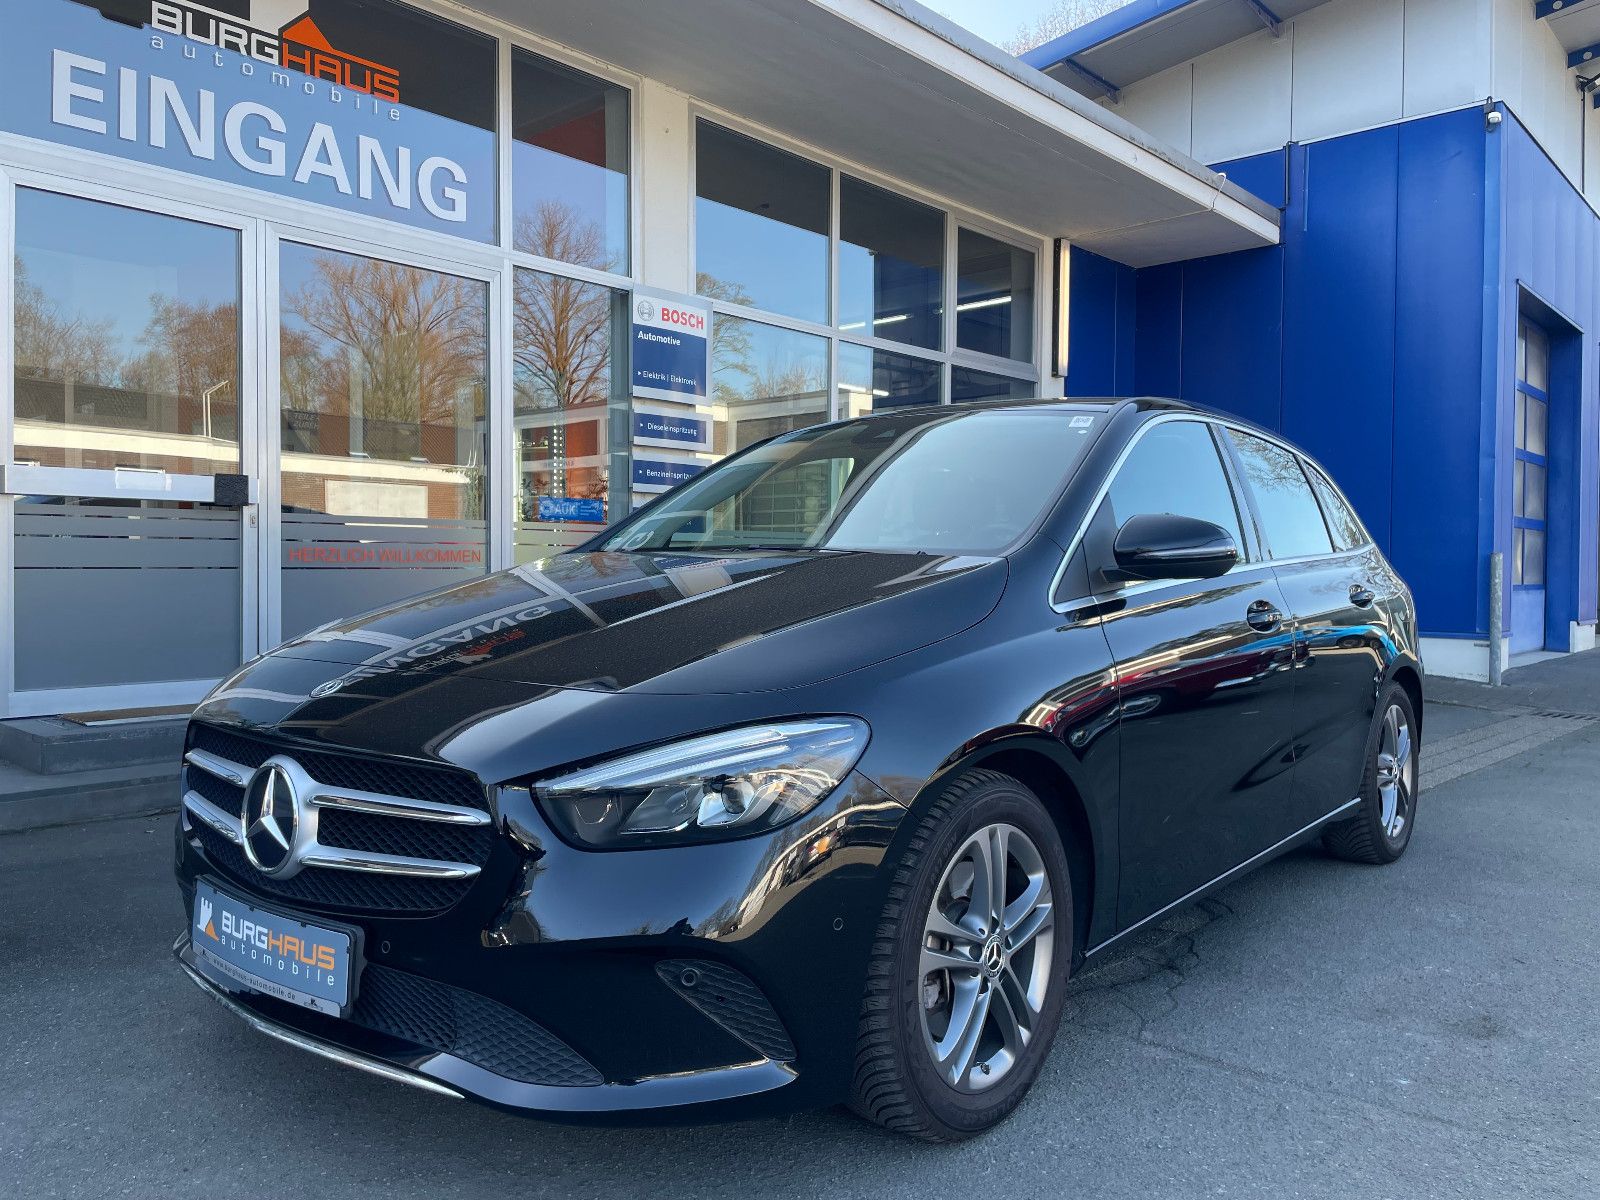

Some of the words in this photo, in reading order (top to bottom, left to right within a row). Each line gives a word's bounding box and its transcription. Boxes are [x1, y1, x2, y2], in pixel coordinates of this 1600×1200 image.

[151, 1, 399, 104] BURGHAUS
[151, 35, 401, 121] automobile
[52, 48, 468, 222] EINGANG
[661, 307, 704, 330] BOSCH
[637, 330, 681, 346] Automotive
[642, 370, 666, 381] Elektrik
[670, 374, 697, 386] Elektronik
[647, 422, 697, 437] Dieseleinspritzung
[288, 546, 375, 563] HERZLICH
[377, 547, 481, 563] WILLKOMMEN
[221, 910, 336, 971] BURGHAUS
[221, 934, 335, 986] automobile
